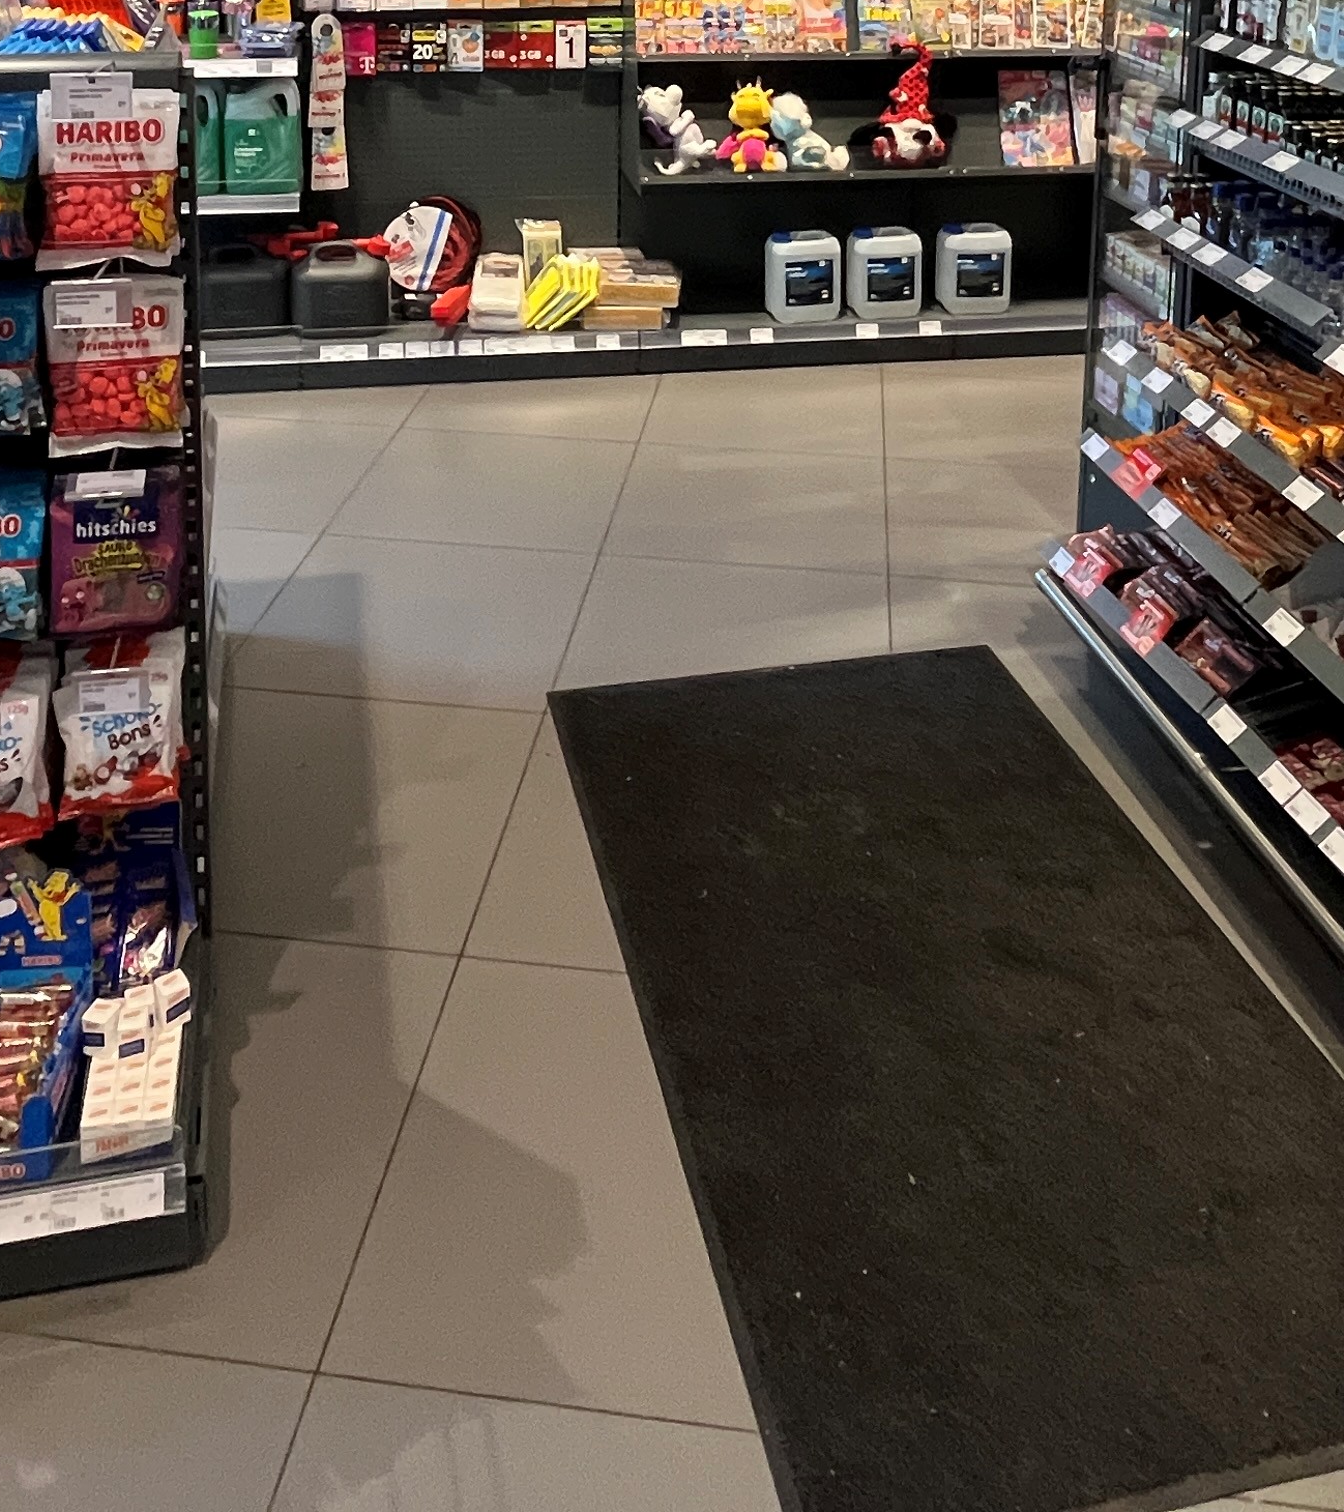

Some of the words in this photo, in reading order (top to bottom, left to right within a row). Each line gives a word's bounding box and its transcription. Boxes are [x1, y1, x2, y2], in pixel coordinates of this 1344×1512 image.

[56, 116, 166, 147] HARIBO
[69, 150, 146, 164] Primavera
[76, 336, 150, 352] Primavera
[75, 518, 157, 539] hitschies
[106, 722, 153, 750] Bons
